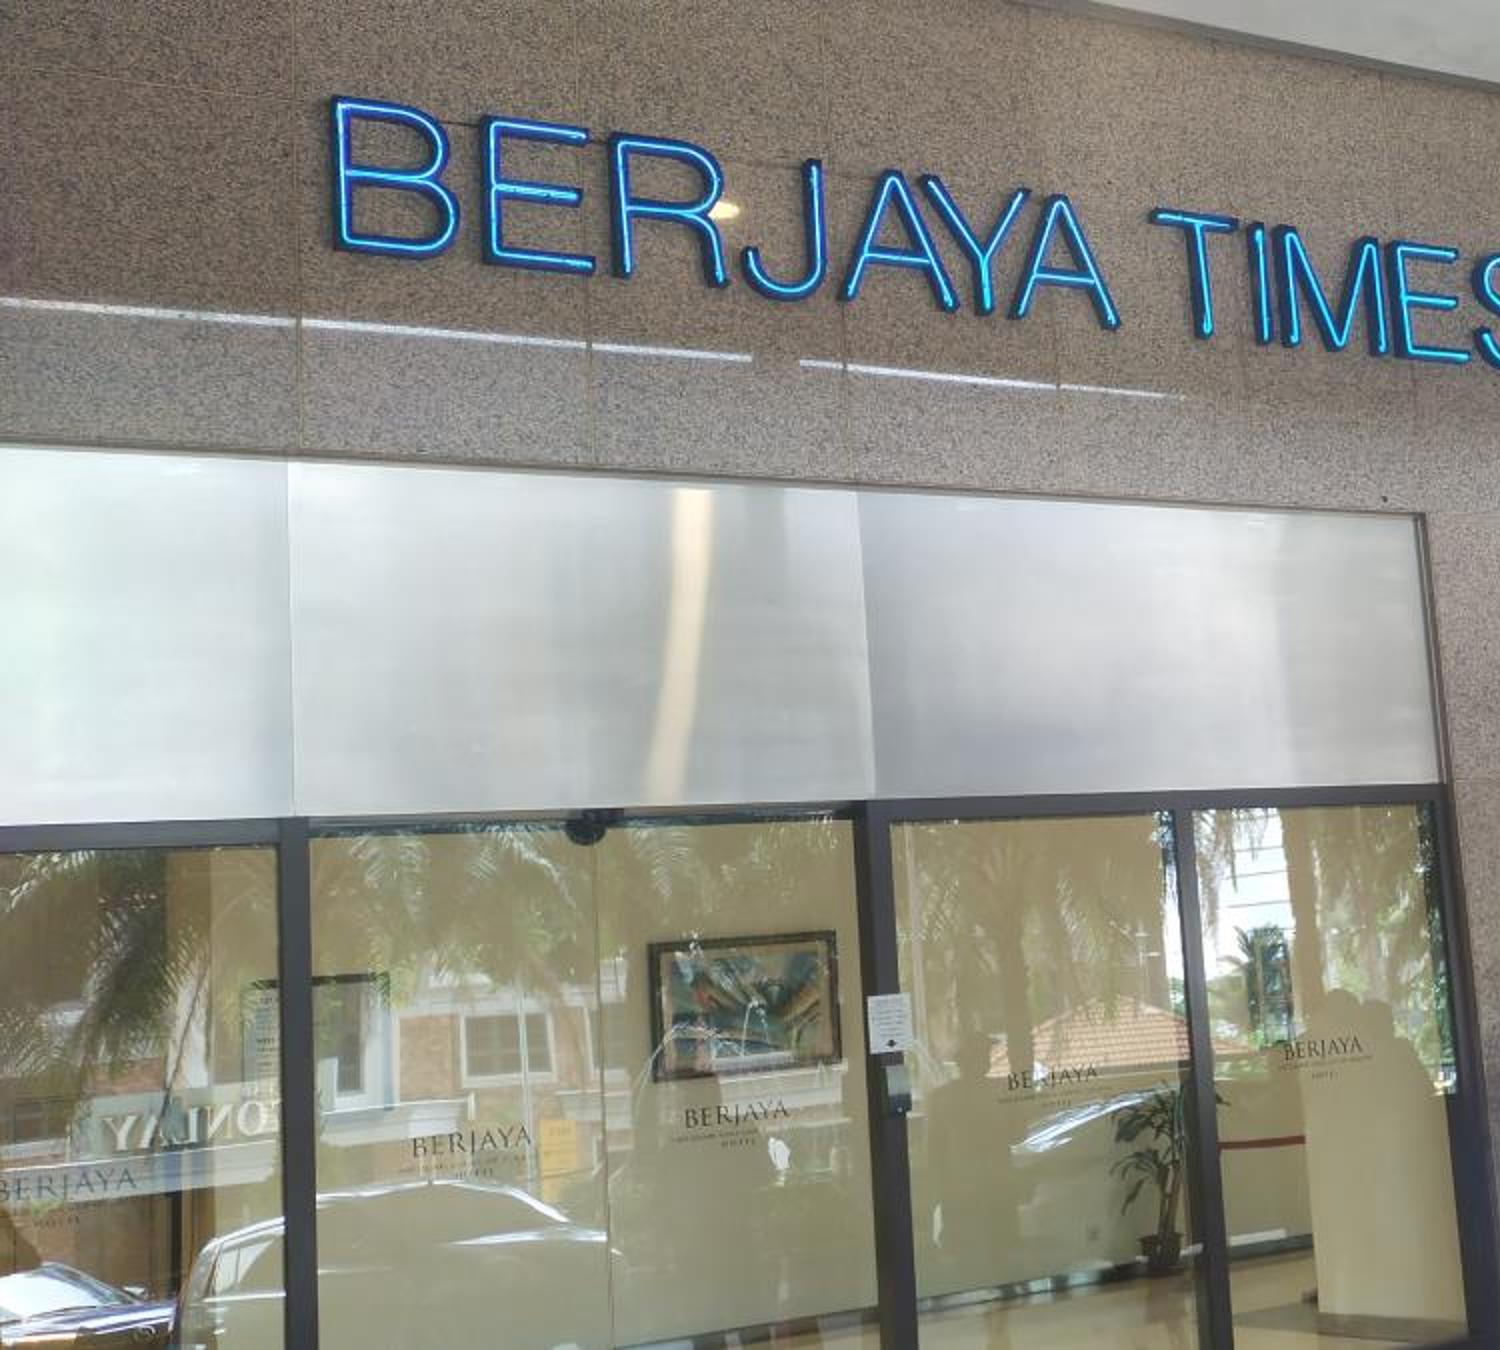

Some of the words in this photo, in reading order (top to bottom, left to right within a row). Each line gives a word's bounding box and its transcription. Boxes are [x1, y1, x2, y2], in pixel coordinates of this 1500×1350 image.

[330, 95, 1121, 329] BERJAYA
[1282, 1035, 1363, 1061] BERJAYA
[684, 1098, 790, 1129] BERJAYA
[412, 1126, 532, 1158] BERJAYA
[0, 1167, 137, 1201] BERJAYA
